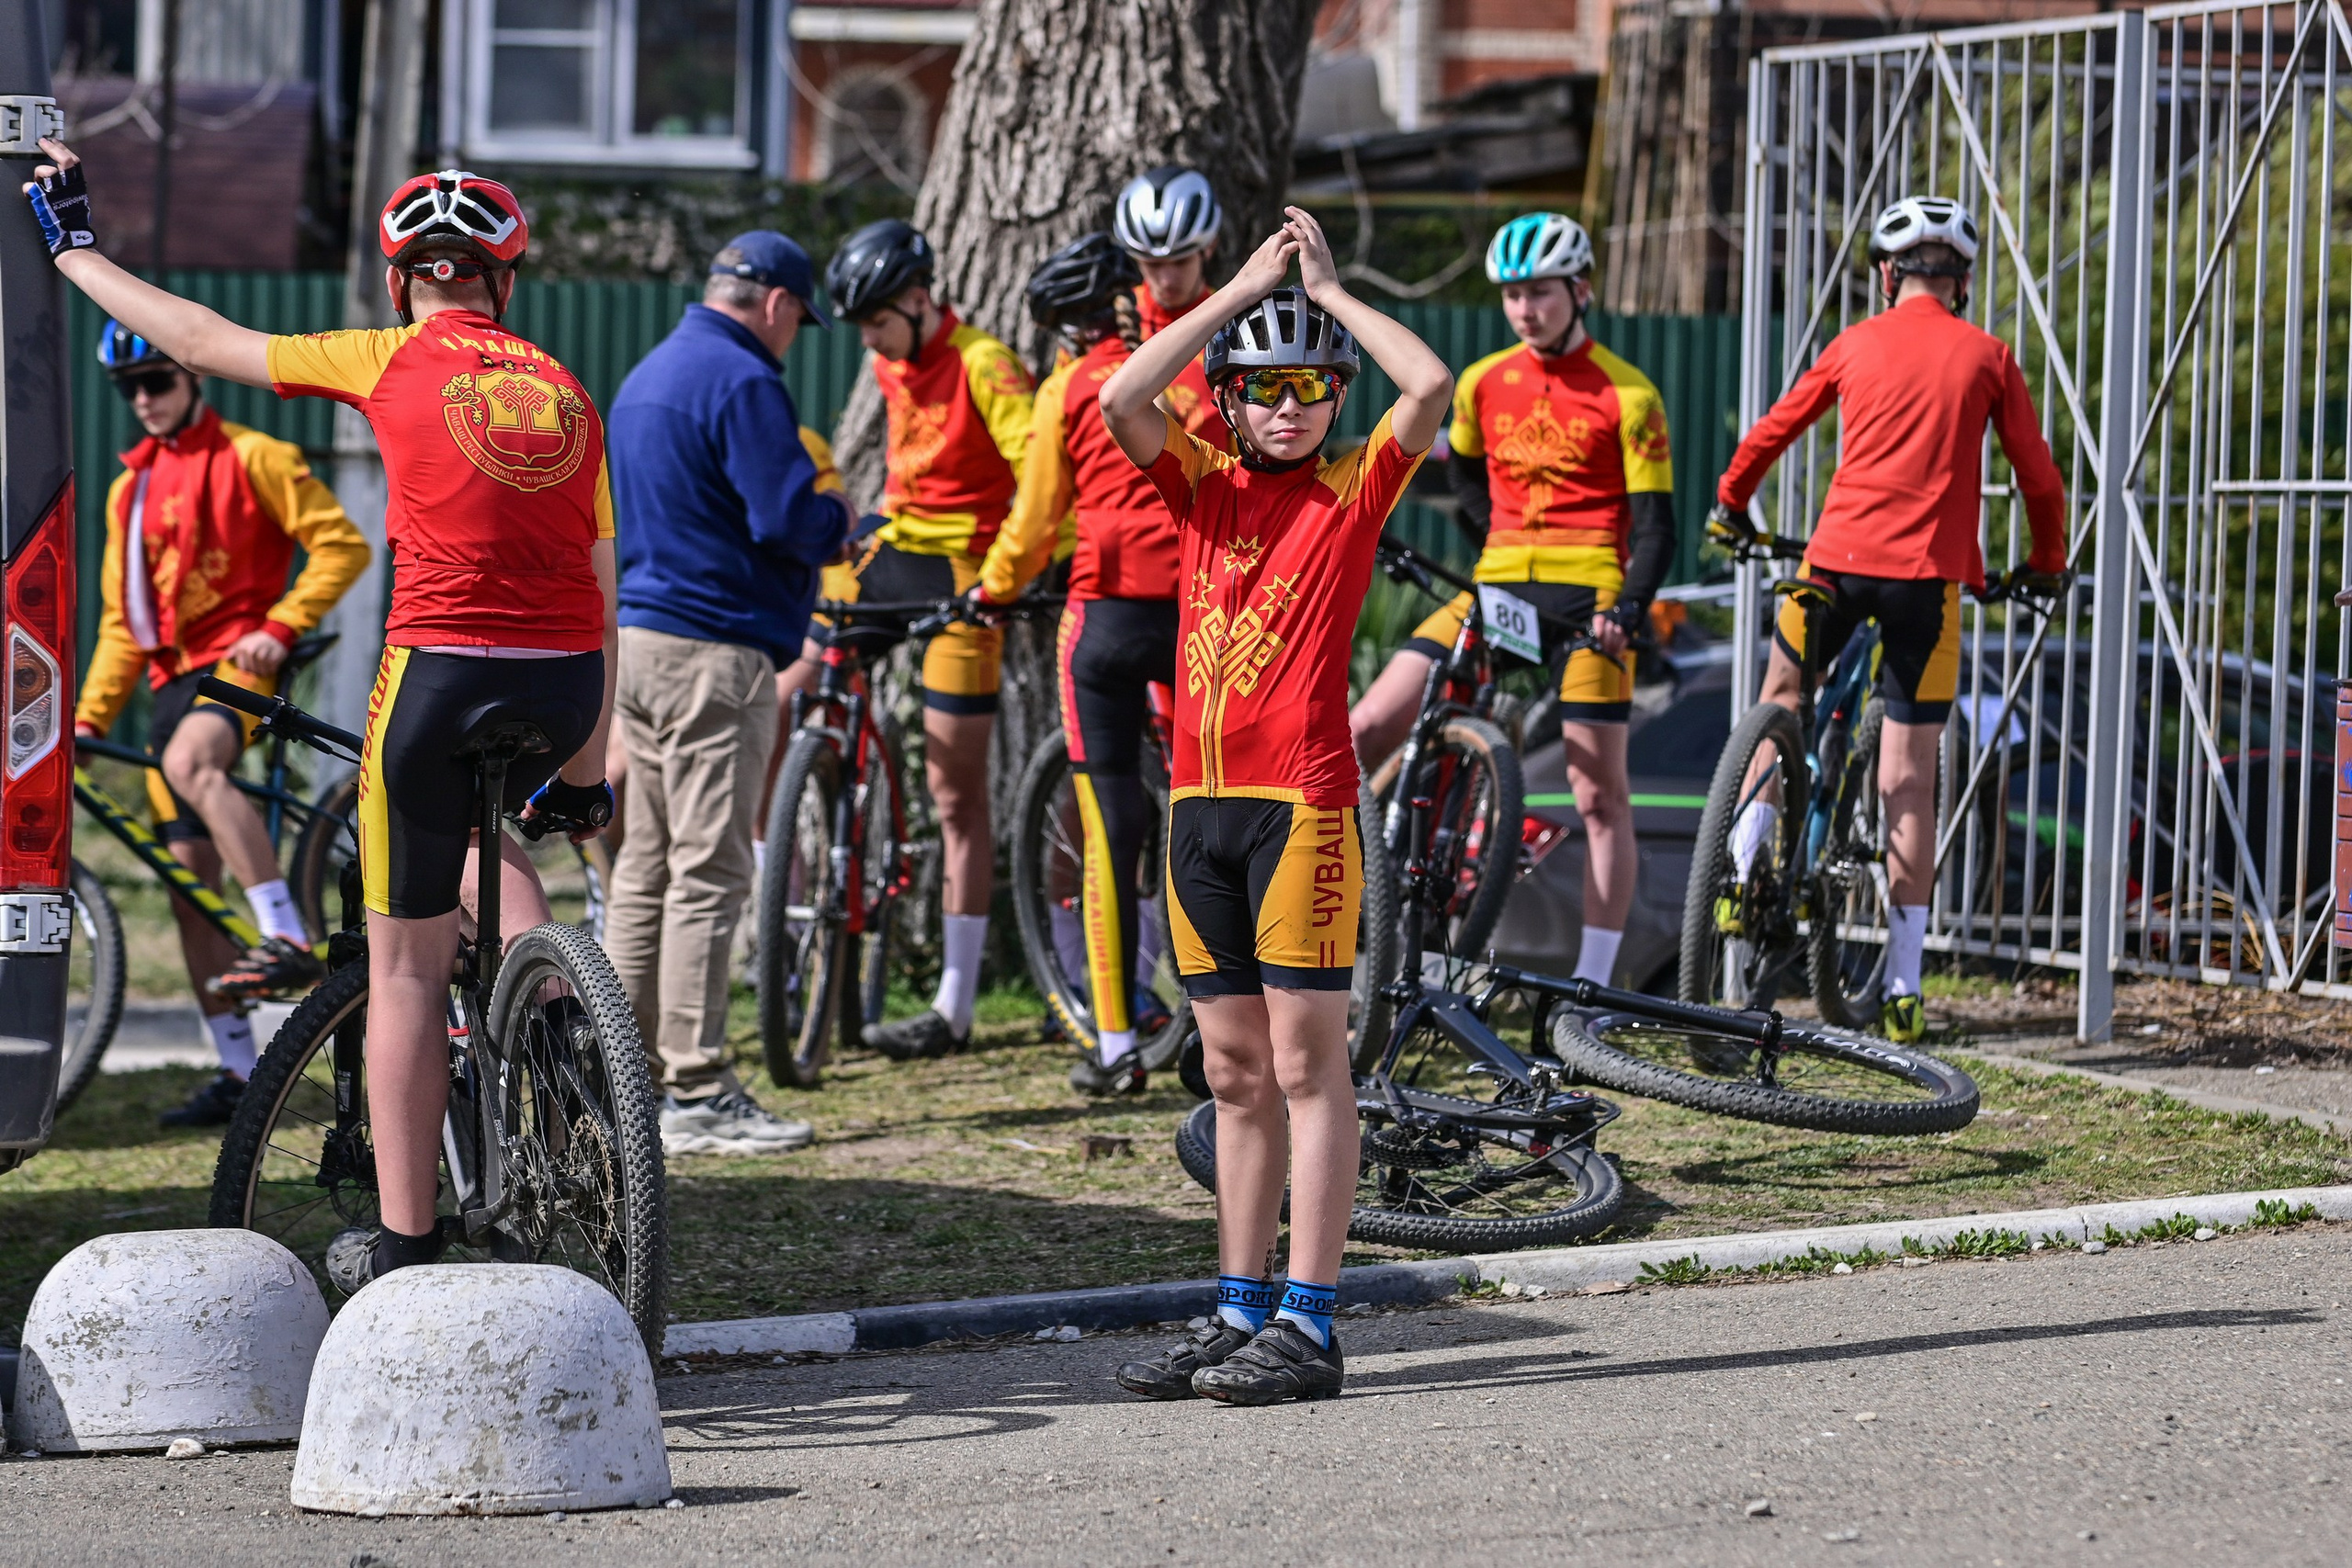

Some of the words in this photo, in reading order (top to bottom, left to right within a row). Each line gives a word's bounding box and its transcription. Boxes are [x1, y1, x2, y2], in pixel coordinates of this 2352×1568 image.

[463, 437, 514, 480] РЕСПУБЛИКИ
[523, 467, 570, 484] ЧУВАШСКАЯ
[569, 422, 585, 468] РЕСПУБЛИКА
[1496, 603, 1526, 636] 80
[358, 646, 399, 802] ЧУВАШИ
